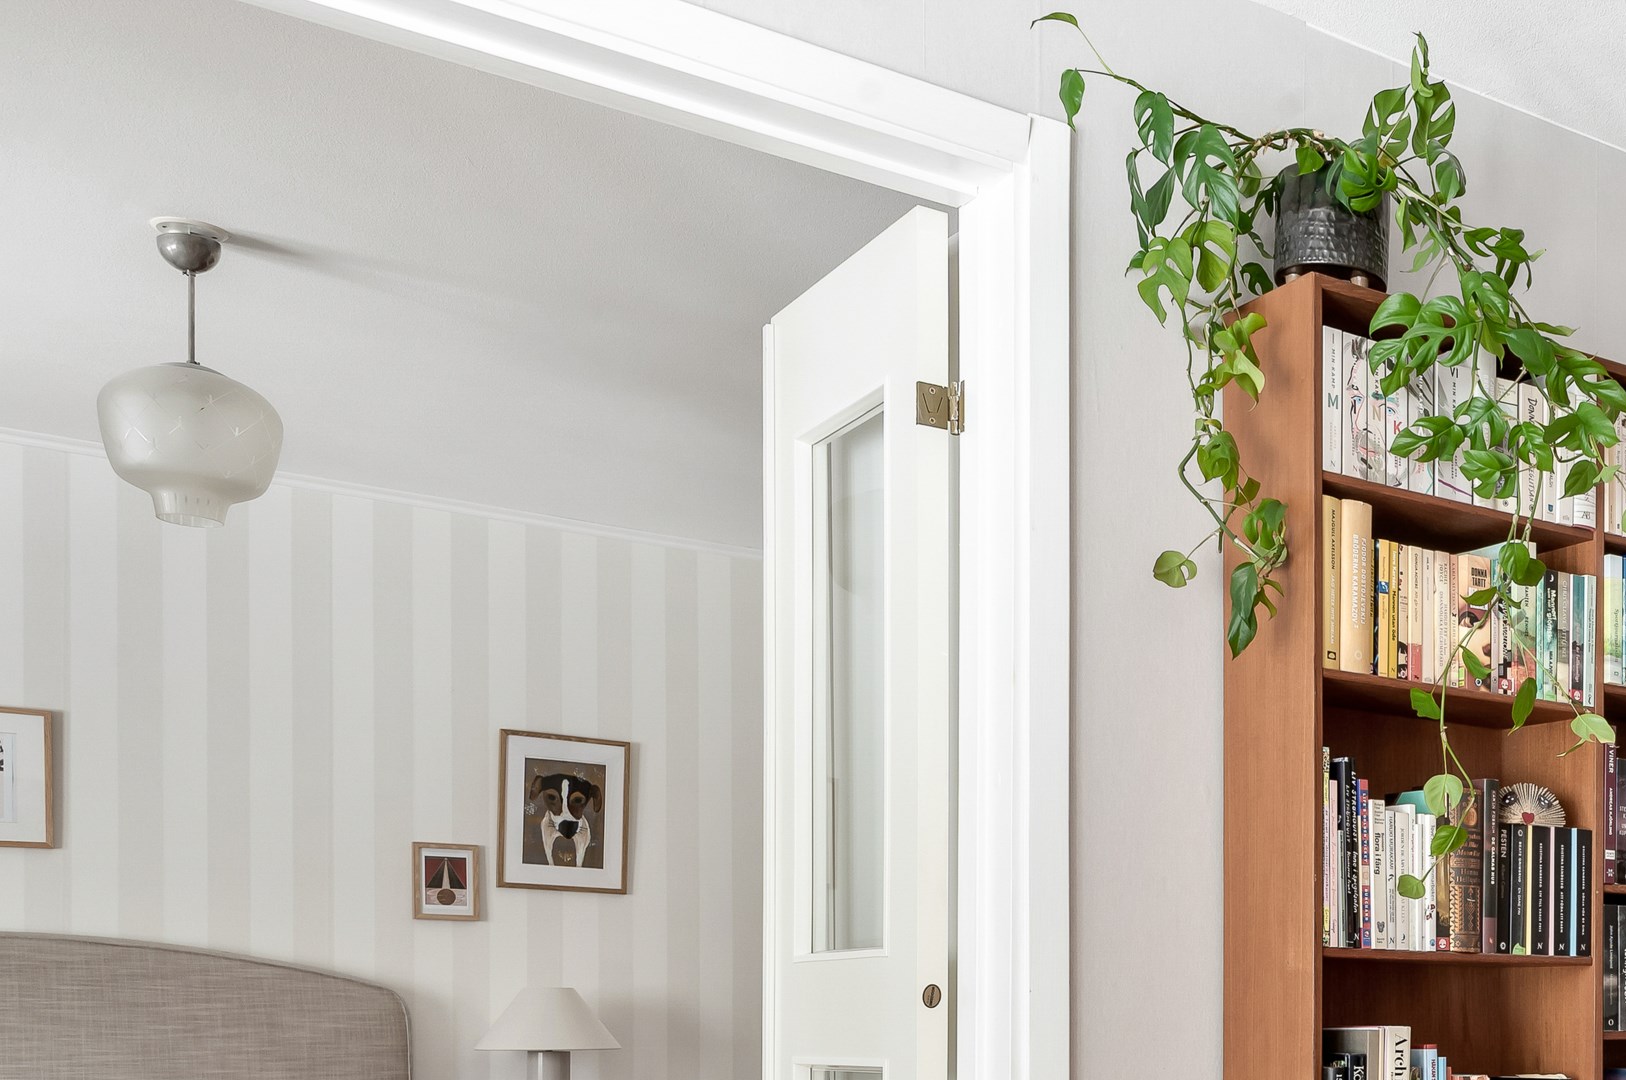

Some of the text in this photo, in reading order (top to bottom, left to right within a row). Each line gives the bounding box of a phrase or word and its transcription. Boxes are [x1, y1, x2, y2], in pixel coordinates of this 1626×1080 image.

[1328, 393, 1338, 409] M
[1351, 575, 1359, 623] KARAMAZOV
[1374, 832, 1382, 852] flora
[1374, 858, 1382, 875] färg
